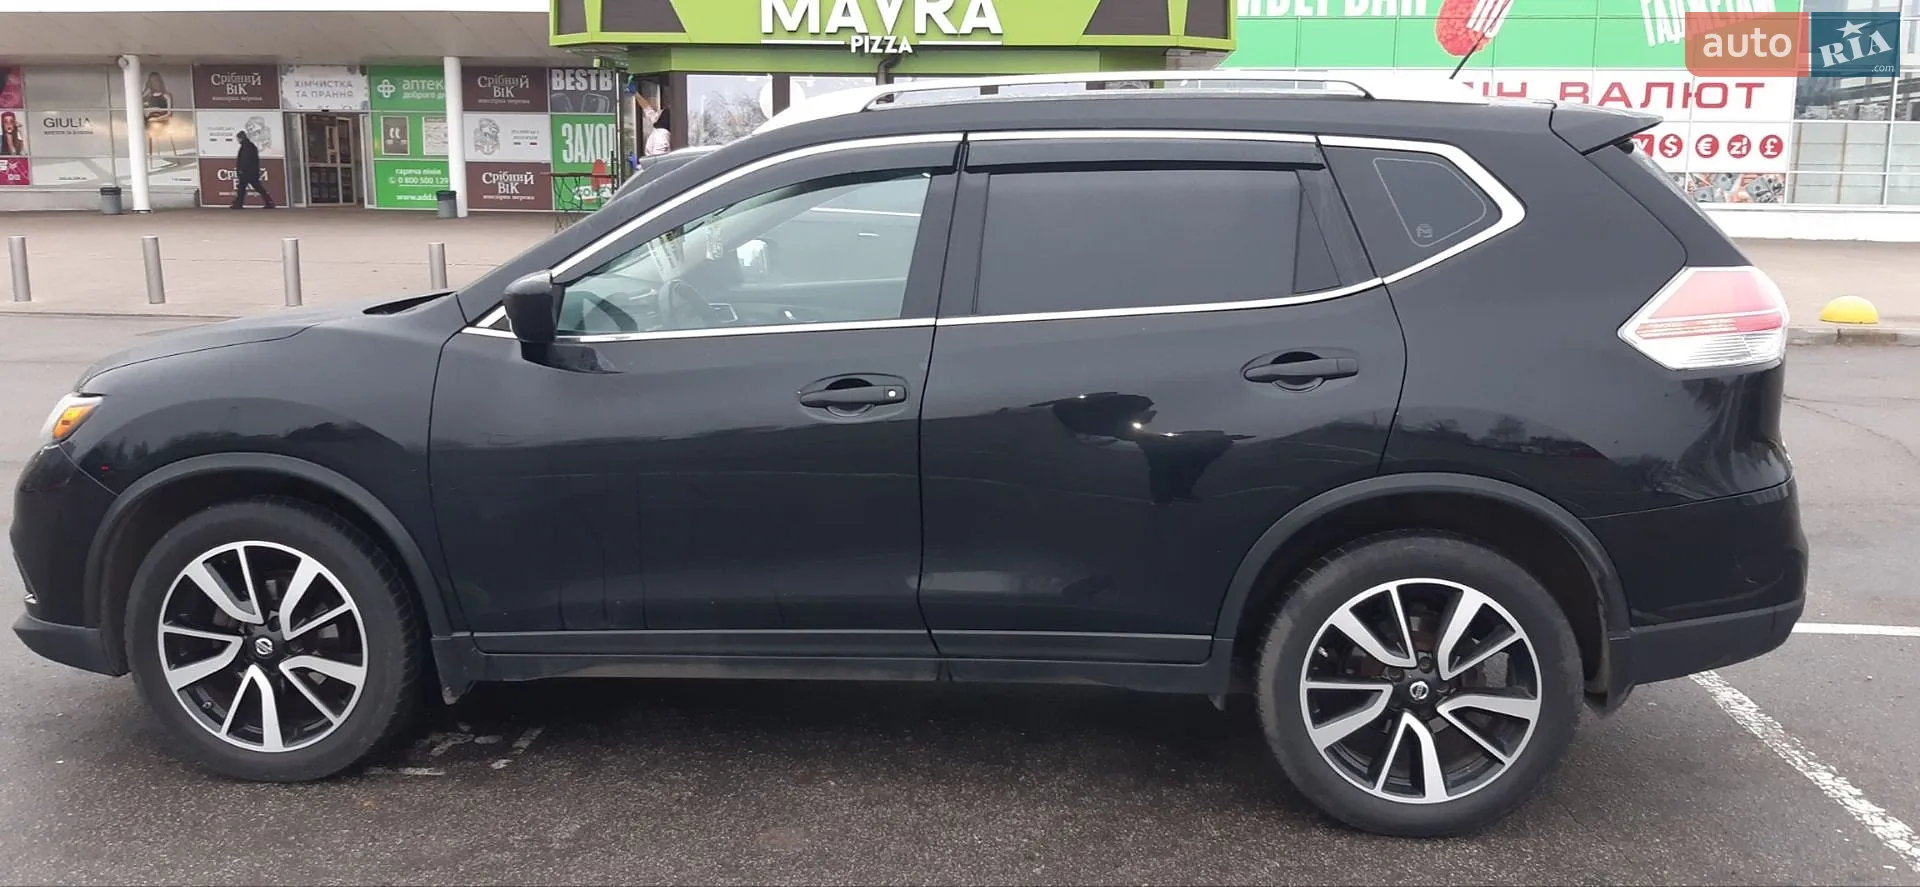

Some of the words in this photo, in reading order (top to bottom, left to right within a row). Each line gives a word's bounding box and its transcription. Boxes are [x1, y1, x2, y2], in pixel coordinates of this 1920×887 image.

[761, 0, 1003, 34] MAVRA
[851, 36, 913, 53] PIZZA
[295, 80, 353, 88] ХІМЧИСТКА
[296, 90, 308, 98] ТА
[1560, 82, 1765, 108] ВАЛЮТ
[43, 117, 91, 128] GIULIA
